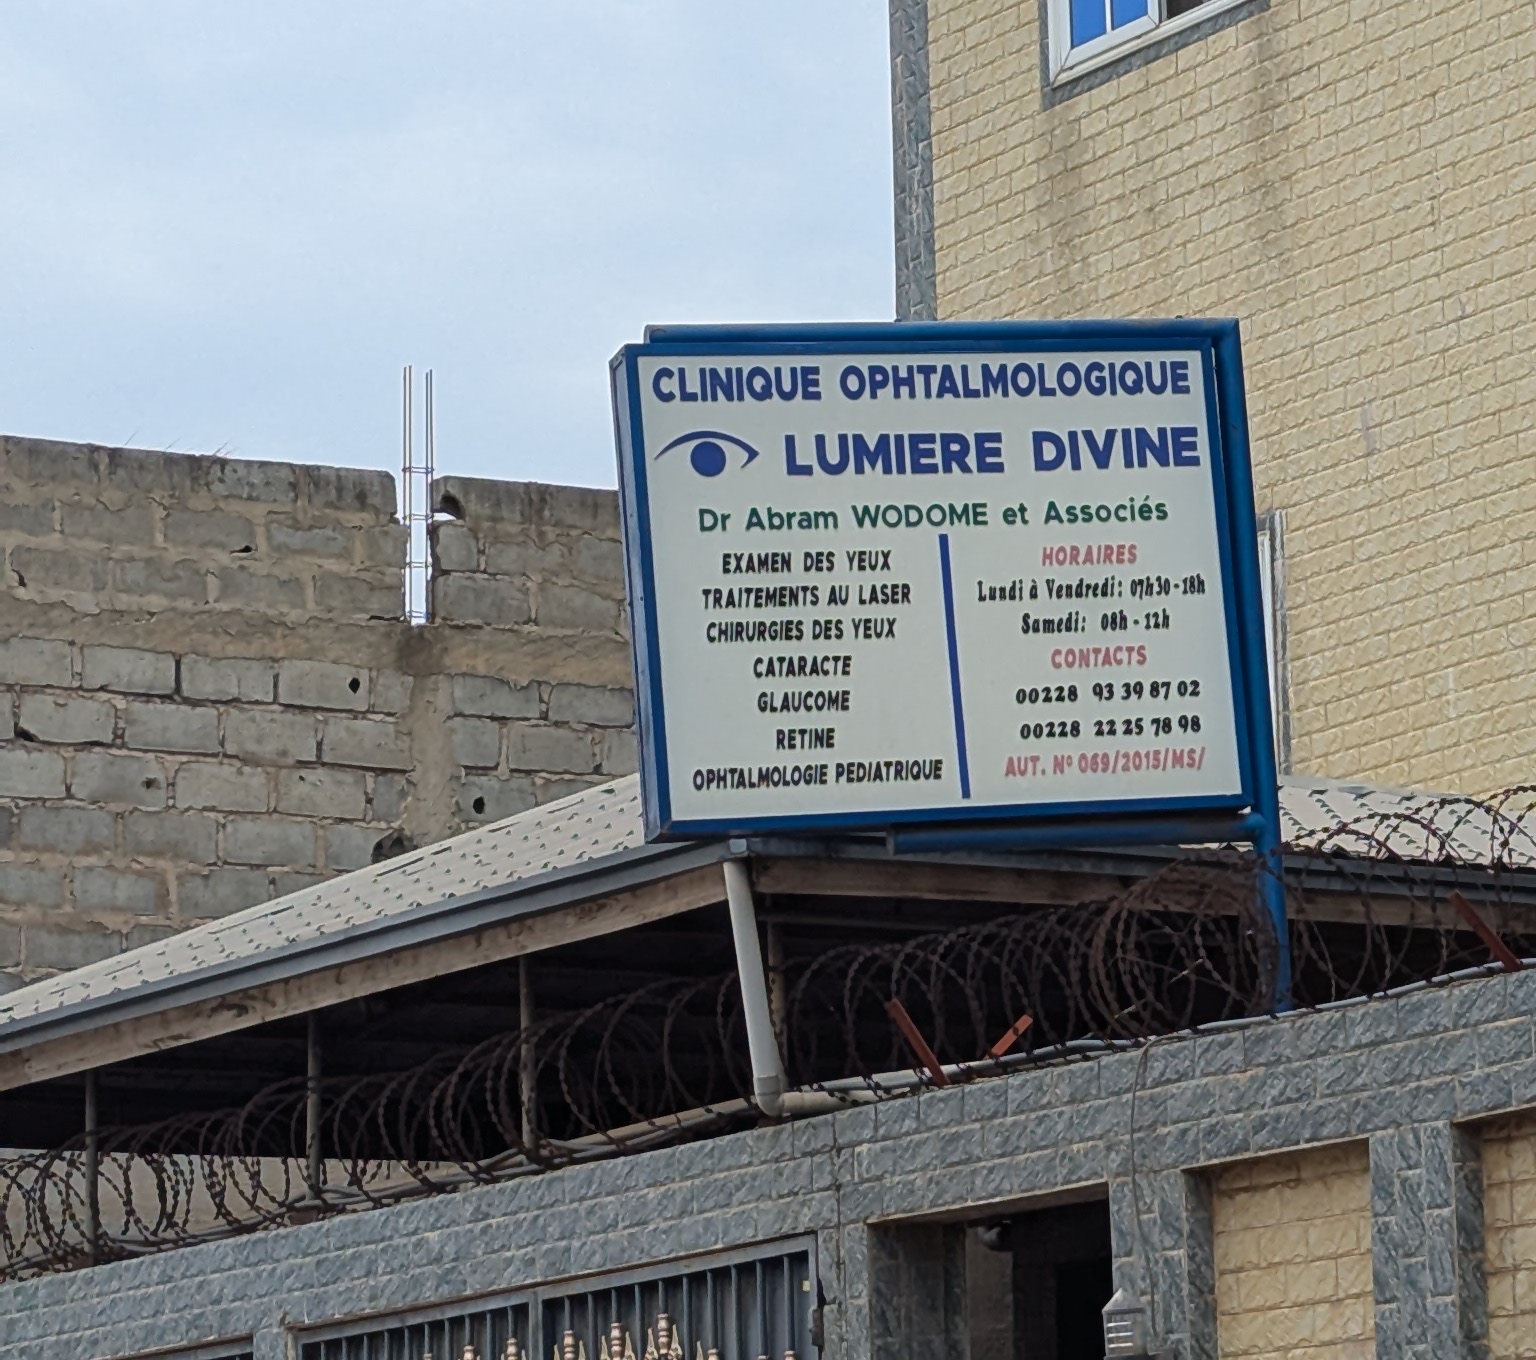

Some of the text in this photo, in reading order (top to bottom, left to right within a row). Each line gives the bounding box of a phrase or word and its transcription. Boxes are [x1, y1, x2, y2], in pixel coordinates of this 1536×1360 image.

[652, 360, 1191, 403] CLINIQUE OPHTALMOLOGIQUE
[784, 426, 1201, 476] LUMIERE DIVINE
[699, 495, 1169, 533] Dr Abram WODOME et Associés
[722, 549, 892, 574] EXAMEN DES YEUX
[1041, 544, 1138, 566] HORAIRES
[702, 583, 911, 610] TRAITEMENTS AU LASER
[977, 579, 1024, 602] Lundi
[1029, 579, 1039, 600] à
[1045, 575, 1123, 600] Vendredi:
[706, 617, 897, 643] CHIRURGIES DES YEUX
[1021, 611, 1087, 634] Samedi:
[1100, 609, 1128, 631] 08h
[1144, 608, 1170, 630] 12h
[753, 655, 852, 678] CATARACTE
[1051, 645, 1147, 669] CONTACTS
[757, 690, 850, 713] GLAUCOME
[1016, 679, 1200, 704] 00228 93 39 87 02
[776, 728, 836, 750] RETINE
[1020, 715, 1201, 739] 00228 22 25 78 98
[693, 759, 944, 791] OPHTALMOLOGIE PEDIATRIQUE
[1004, 755, 1046, 777] AUT.
